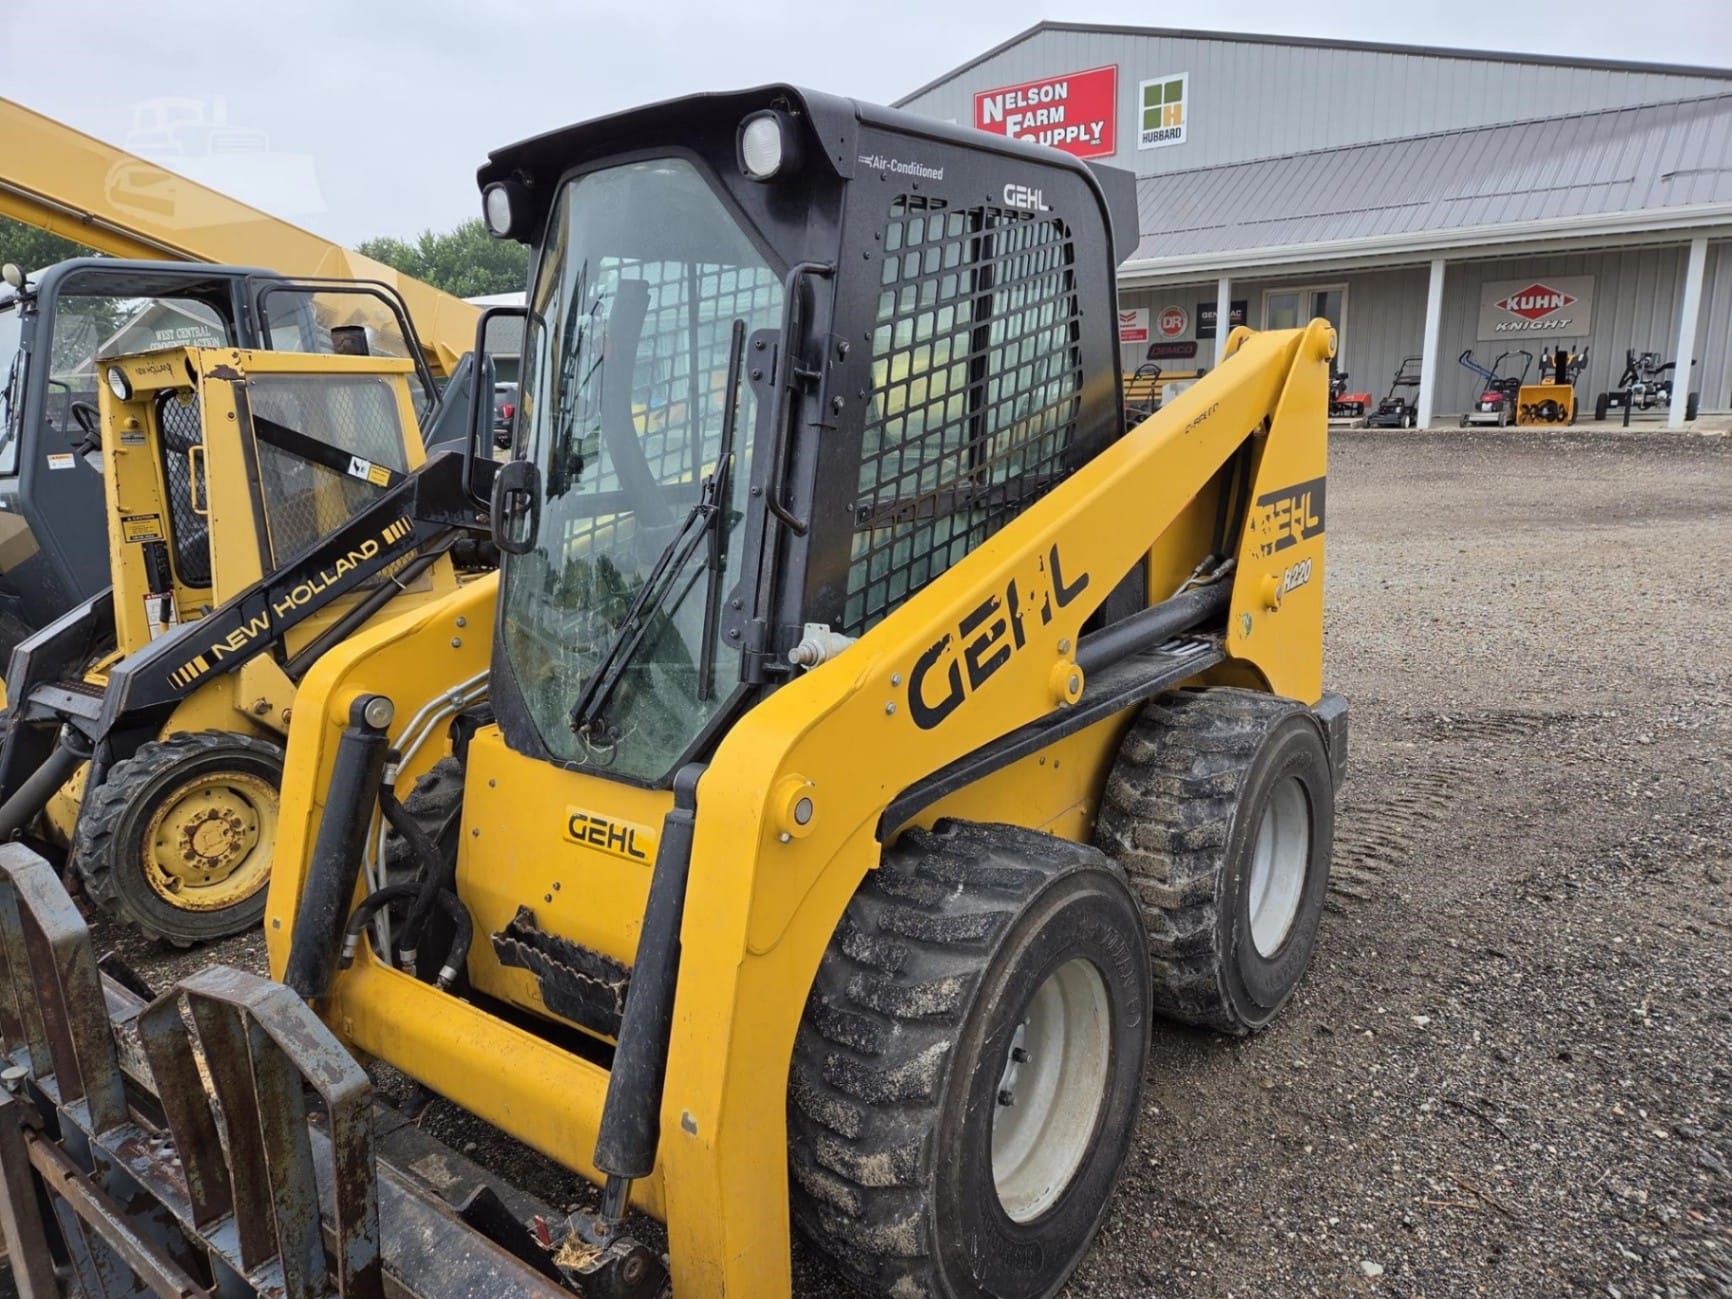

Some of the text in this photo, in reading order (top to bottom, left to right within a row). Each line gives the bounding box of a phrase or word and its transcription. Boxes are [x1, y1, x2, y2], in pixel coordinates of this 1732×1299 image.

[983, 82, 1068, 124] NELSON
[1006, 105, 1065, 137] FARM
[1143, 127, 1182, 144] HUBBARD
[872, 155, 944, 180] Air-Conditioned
[1003, 183, 1049, 211] GEHL
[1506, 294, 1565, 311] KUHN
[1163, 315, 1182, 329] DR
[1495, 319, 1571, 331] KNIGHT
[211, 539, 379, 660] NEW HOLLAND
[569, 813, 645, 859] GEHL
